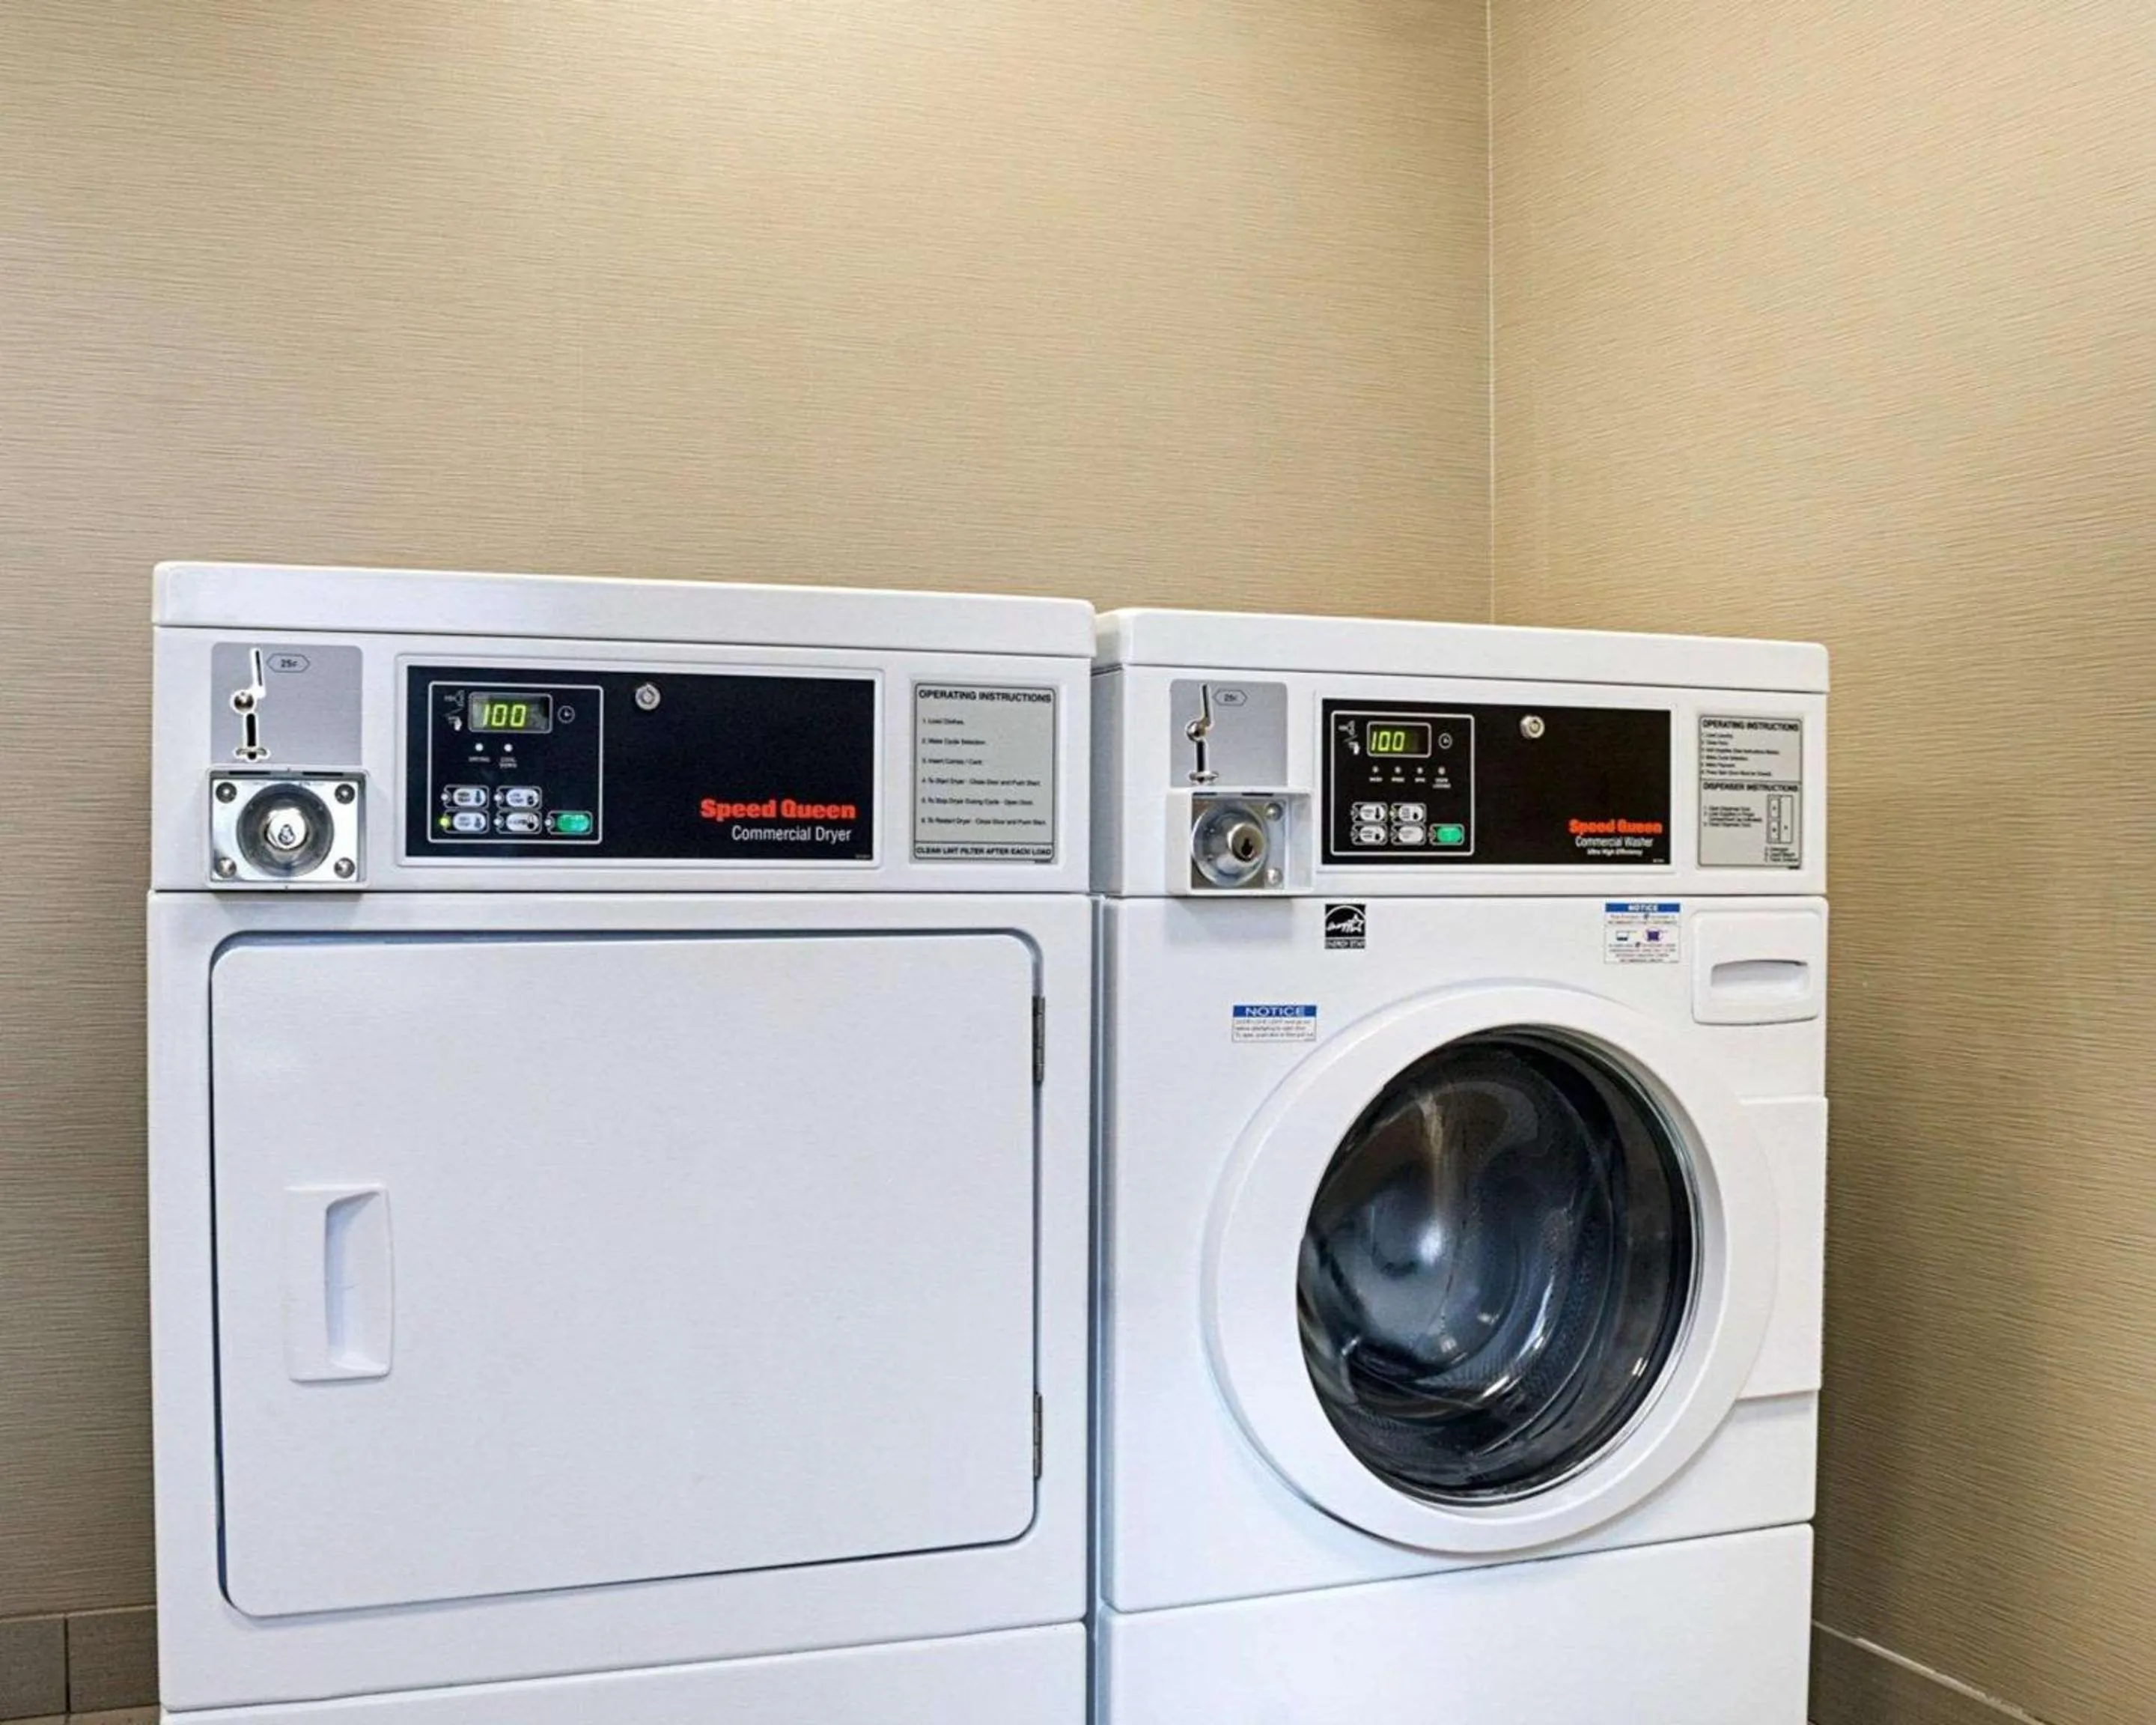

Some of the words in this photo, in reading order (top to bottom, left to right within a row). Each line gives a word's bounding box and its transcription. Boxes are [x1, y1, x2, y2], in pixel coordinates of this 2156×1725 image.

[919, 690, 976, 701] OPERATING
[978, 690, 1052, 703] INSTRUCTIONS
[481, 704, 527, 728] 100
[1703, 719, 1744, 729] OPERATING
[1371, 731, 1406, 752] 100
[701, 798, 777, 821] Speed
[781, 798, 856, 819] Queen
[731, 825, 811, 841] Commercial
[815, 826, 852, 845] Dryer
[1569, 818, 1616, 836] Speed
[1617, 818, 1663, 833] Queen
[1575, 836, 1622, 848] Commercial
[1624, 837, 1654, 848] Washer
[1246, 1006, 1304, 1017] NOTICE
